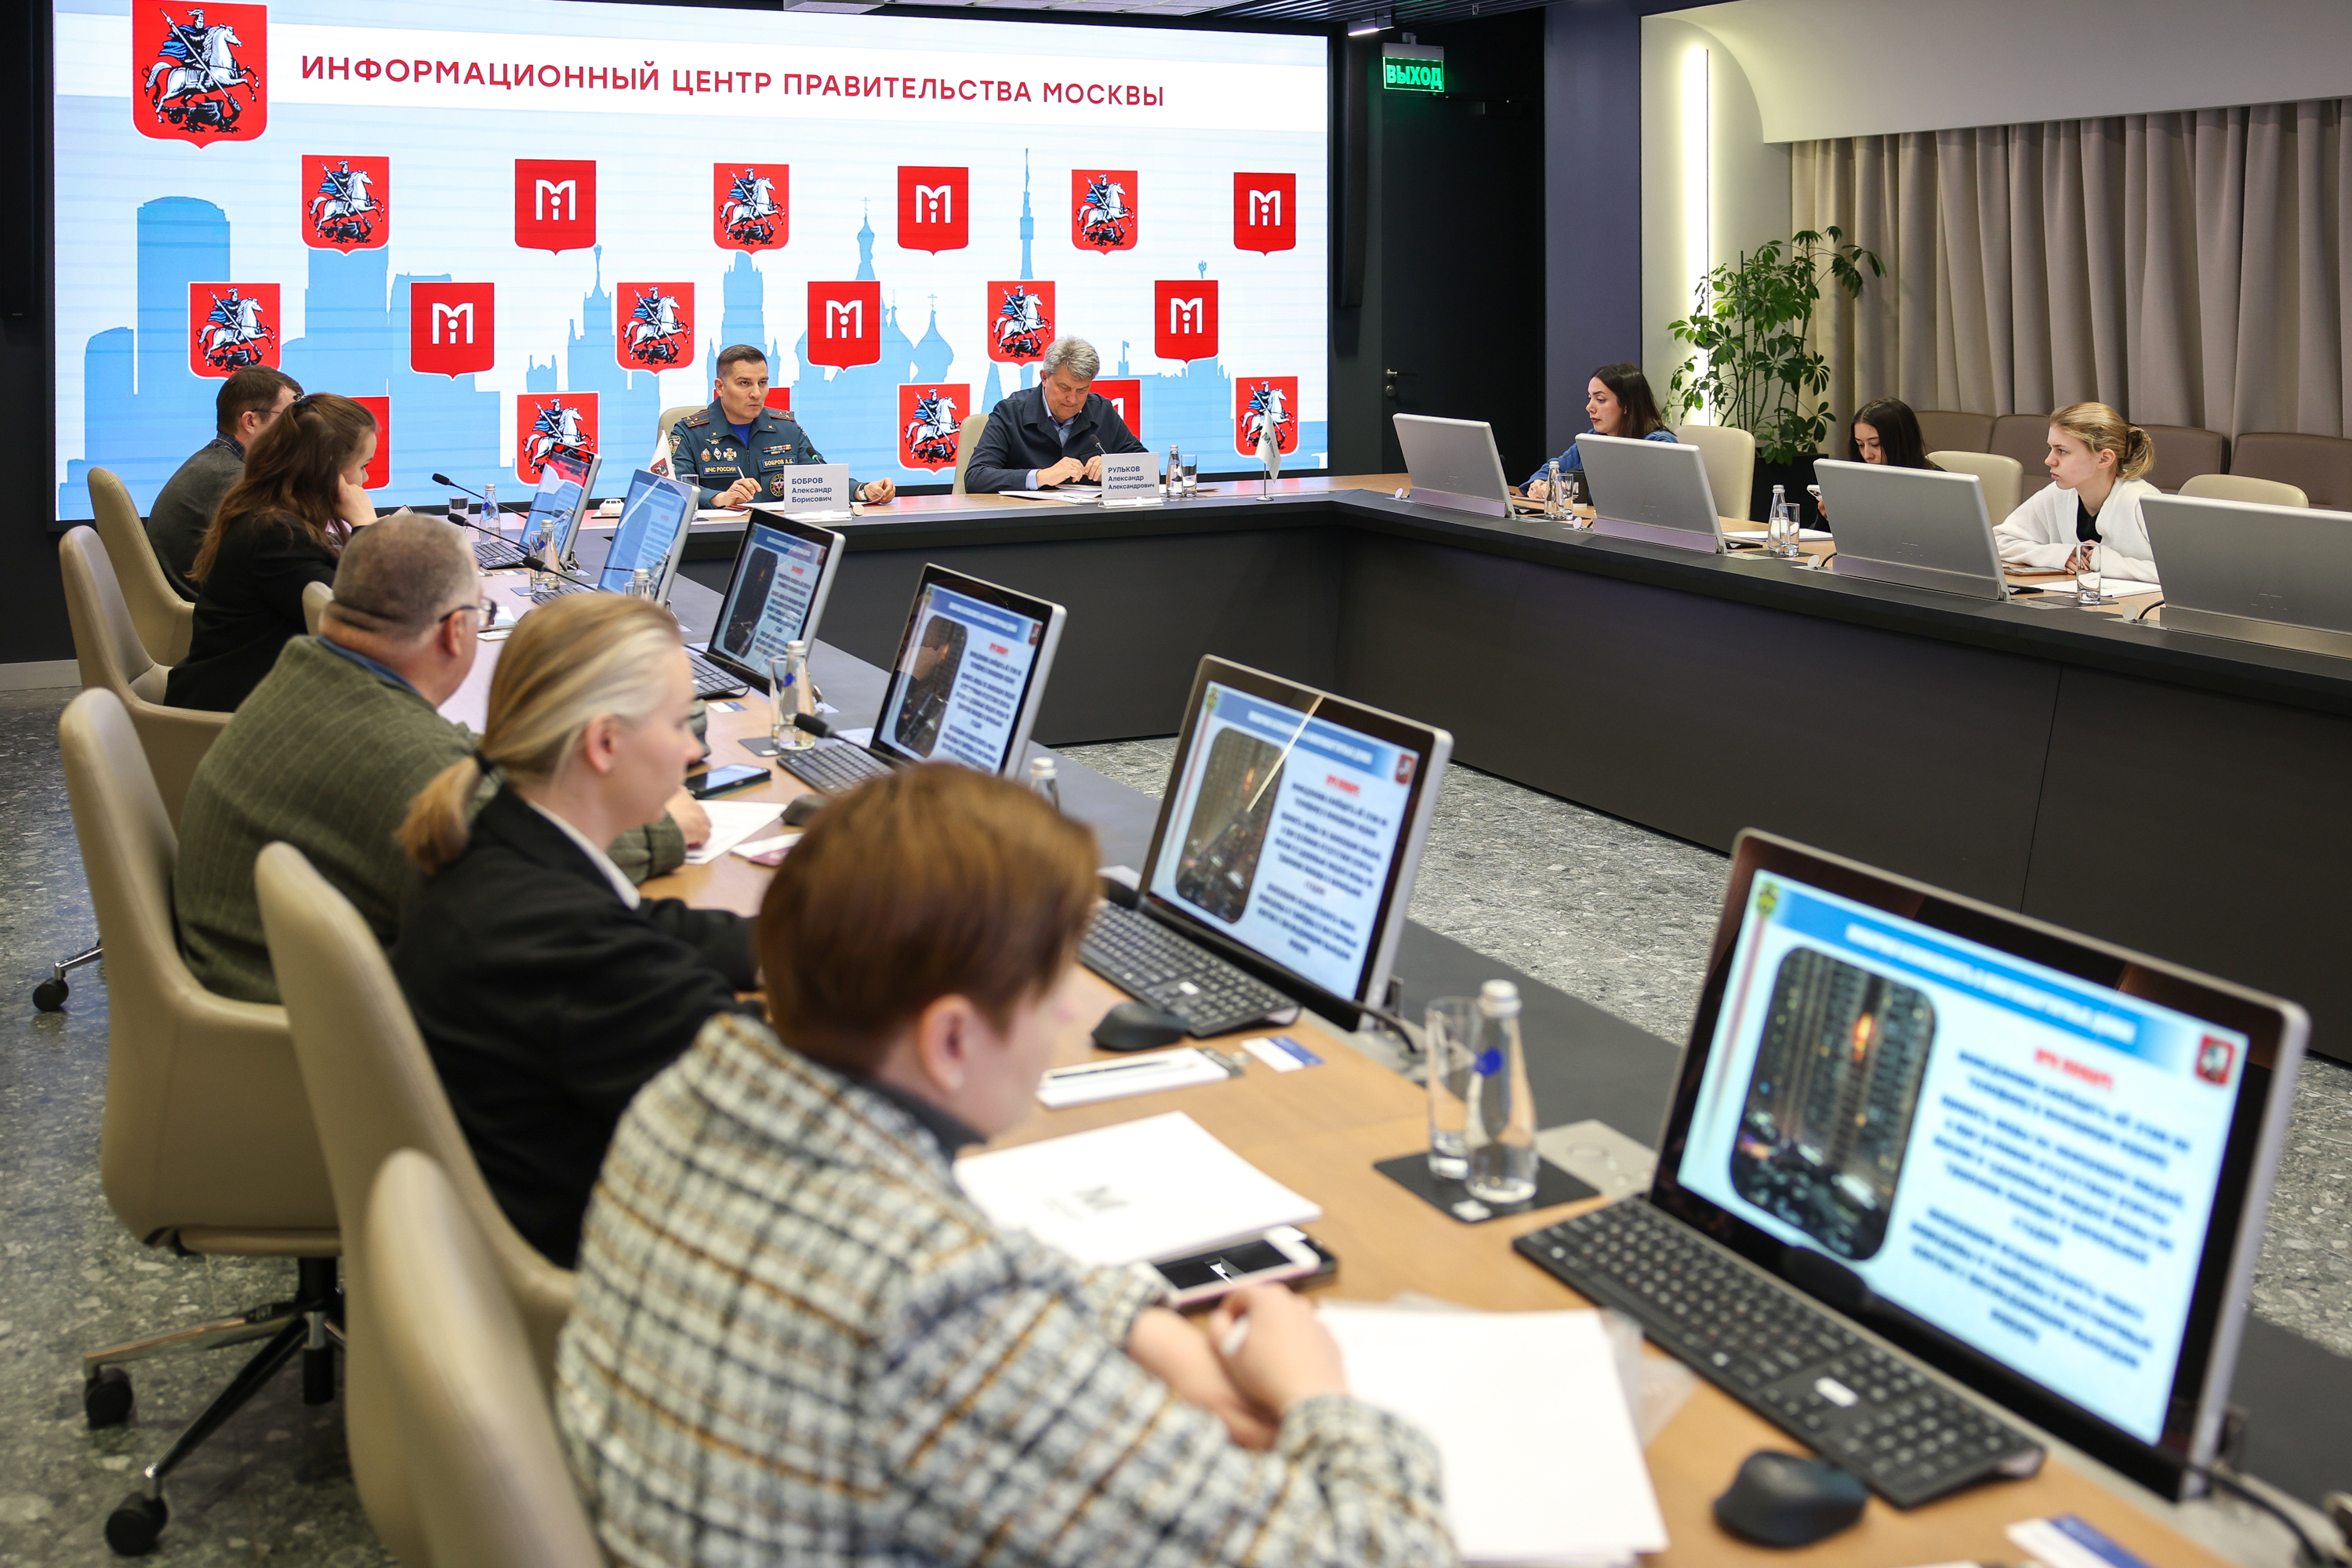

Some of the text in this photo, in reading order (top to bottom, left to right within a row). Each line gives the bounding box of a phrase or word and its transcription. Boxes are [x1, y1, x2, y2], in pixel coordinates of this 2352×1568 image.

[302, 56, 1164, 107] ИНФОРМАЦИОННЫЙ ЦЕНТР ПРАВИТЕЛЬСТВА МОСКВЫ
[1385, 64, 1443, 90] ВЫХОД
